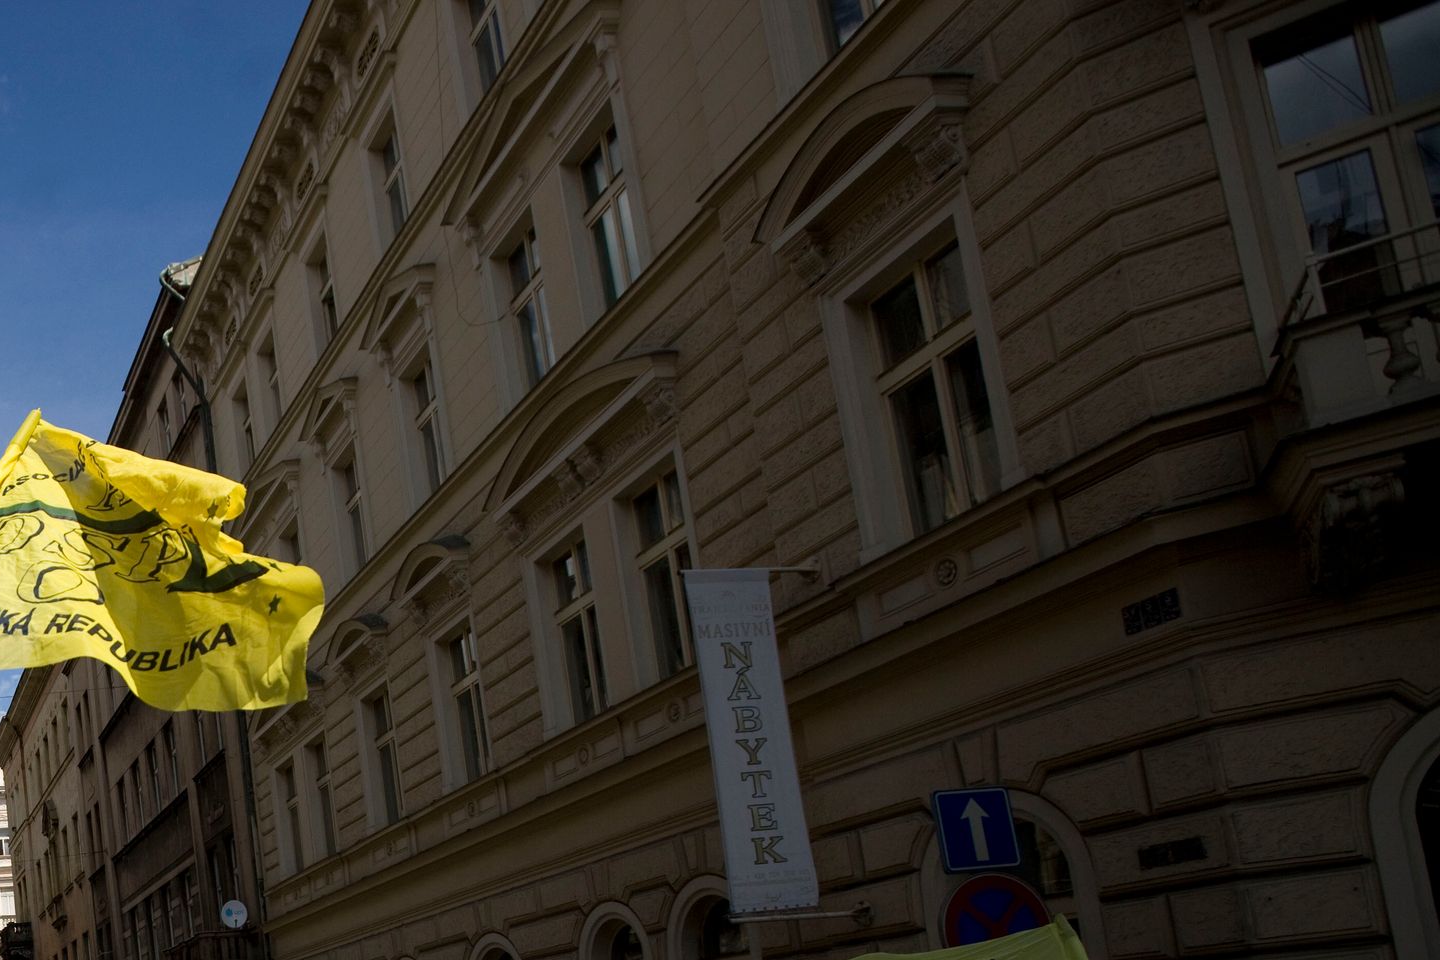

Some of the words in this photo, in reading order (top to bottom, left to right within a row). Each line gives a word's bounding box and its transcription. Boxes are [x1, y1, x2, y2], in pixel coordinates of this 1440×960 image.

[44, 613, 238, 673] REPUBLIKA
[697, 618, 772, 640] MASIVNÍ
[721, 641, 789, 865] NÁBYTEK
